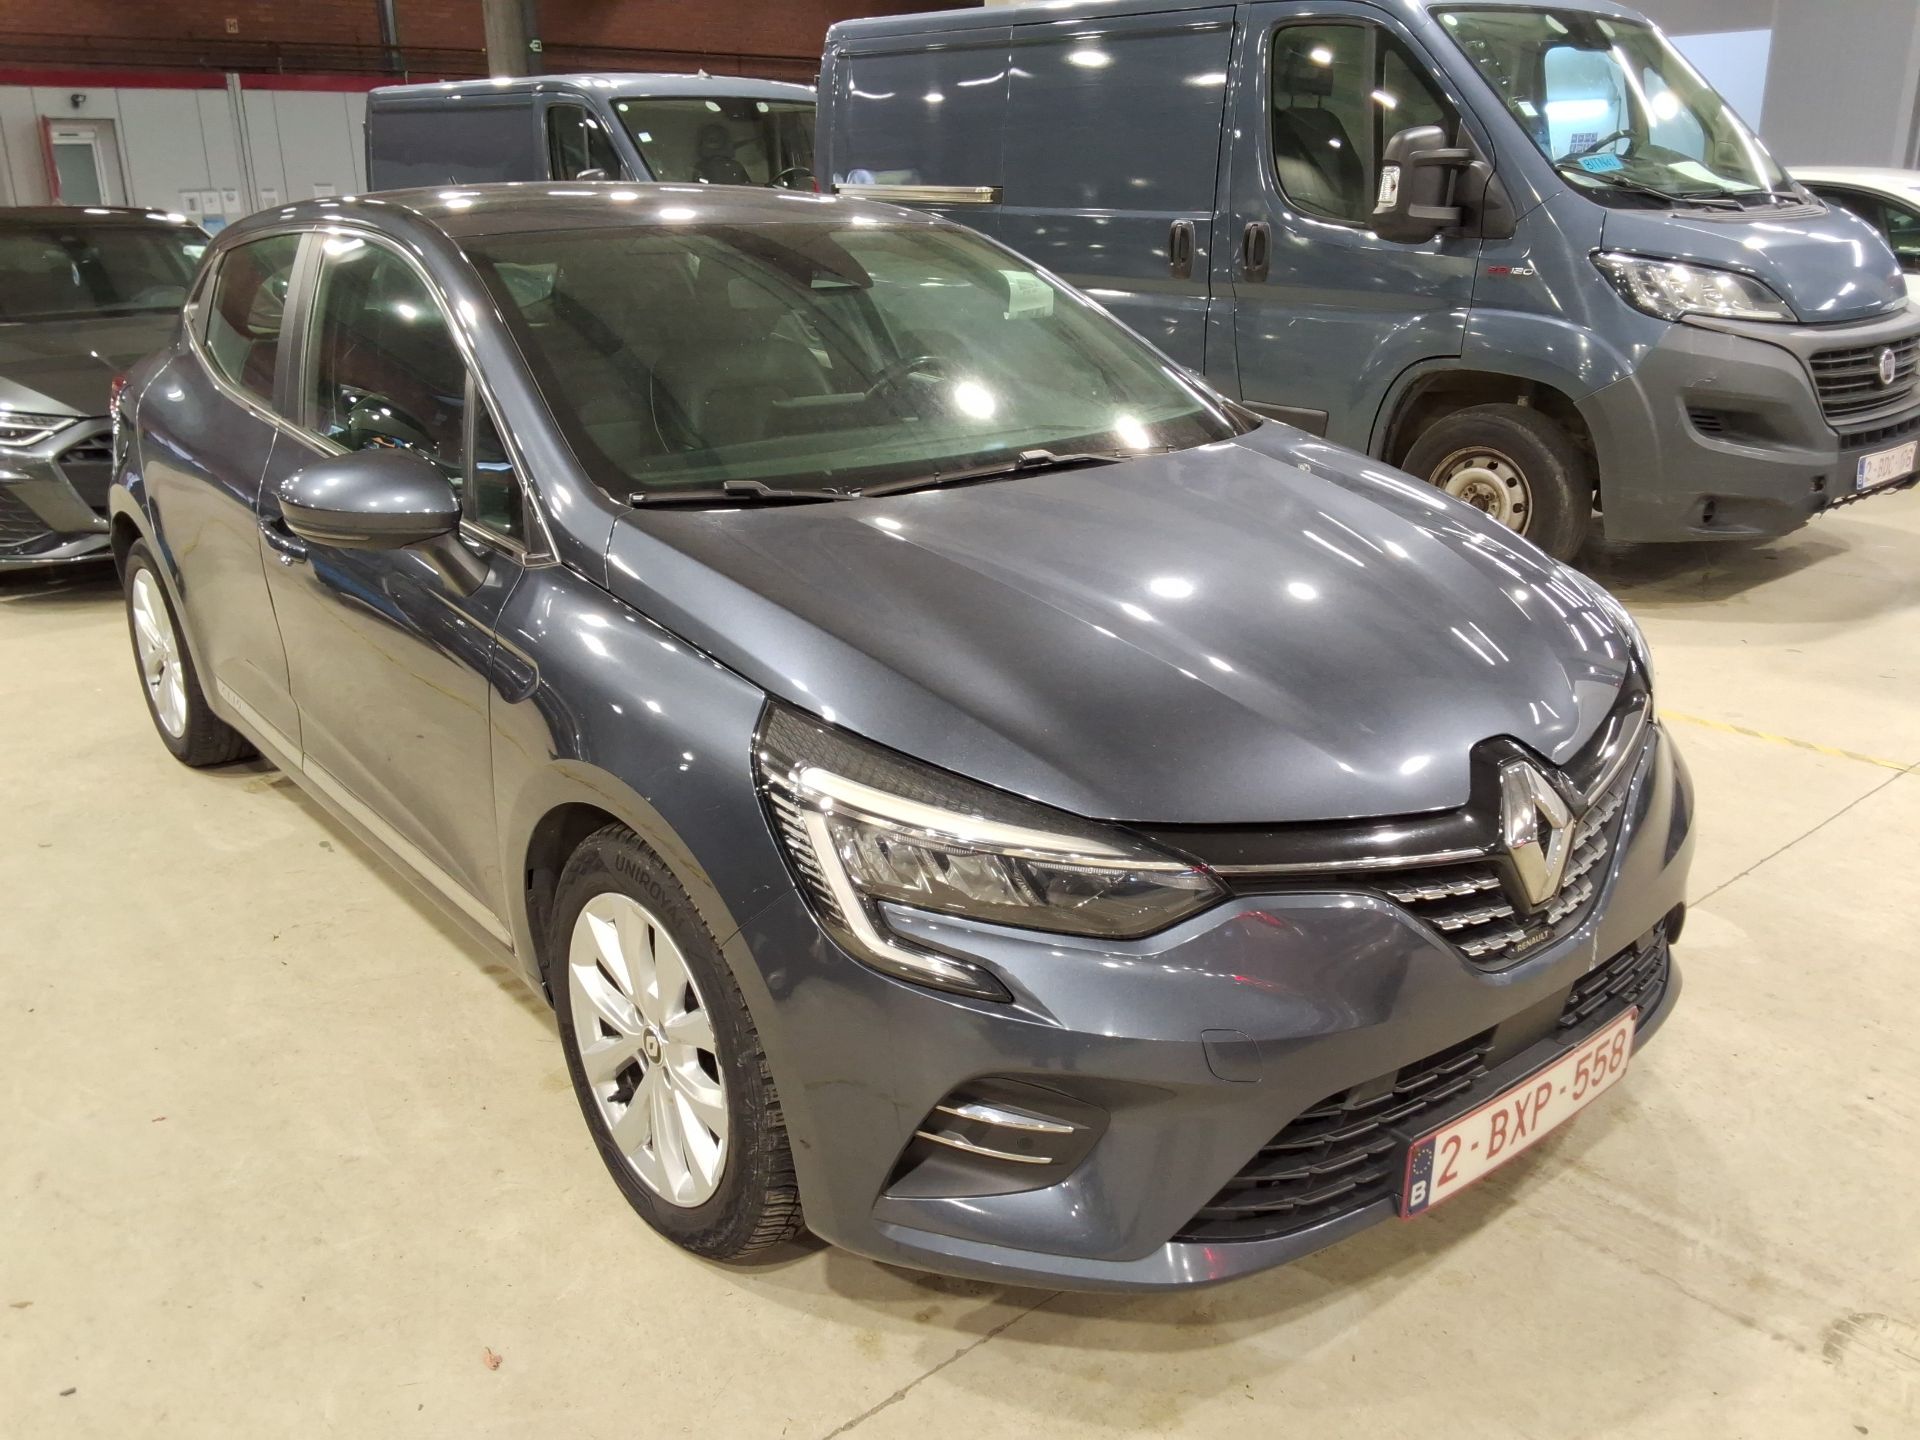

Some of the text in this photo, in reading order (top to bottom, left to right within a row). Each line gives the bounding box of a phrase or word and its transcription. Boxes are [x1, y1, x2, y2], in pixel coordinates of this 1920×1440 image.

[1517, 930, 1548, 952] RENAULT
[1436, 1028, 1627, 1188] 2-BXP-558
[1410, 1179, 1426, 1207] B
